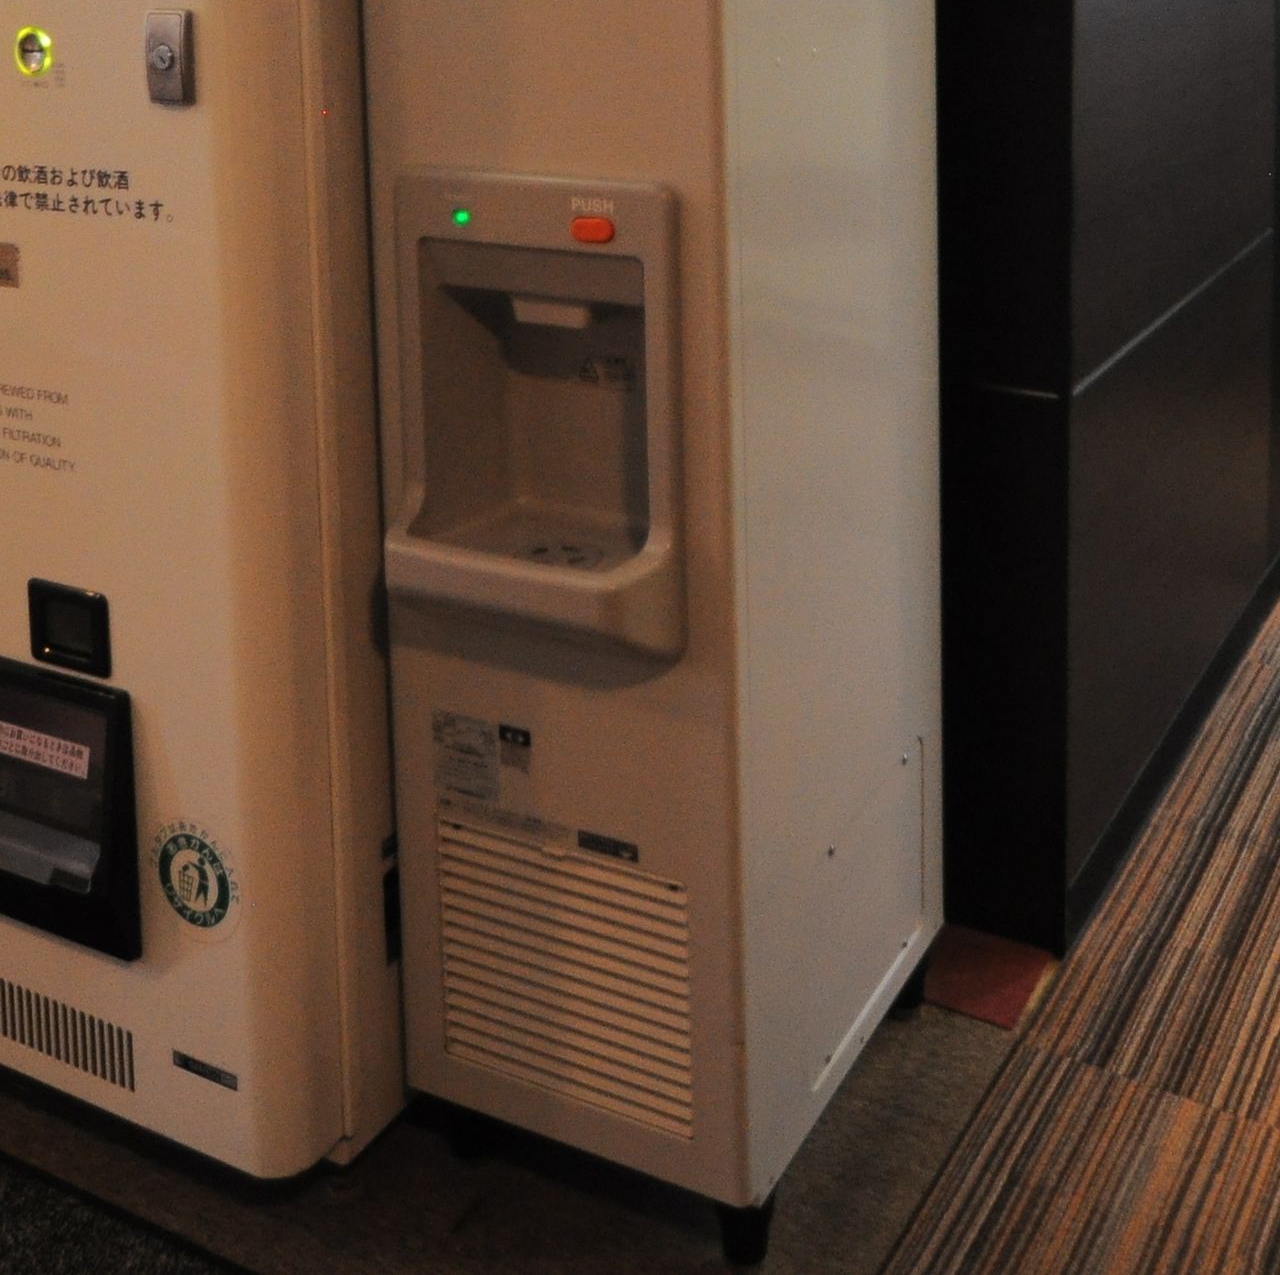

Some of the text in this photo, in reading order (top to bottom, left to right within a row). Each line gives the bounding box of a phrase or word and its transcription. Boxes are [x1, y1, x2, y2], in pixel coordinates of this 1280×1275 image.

[571, 197, 614, 214] PUSH
[37, 389, 69, 405] FROM
[6, 407, 33, 421] WITH
[2, 427, 62, 447] FILTRATION
[13, 450, 28, 463] OF
